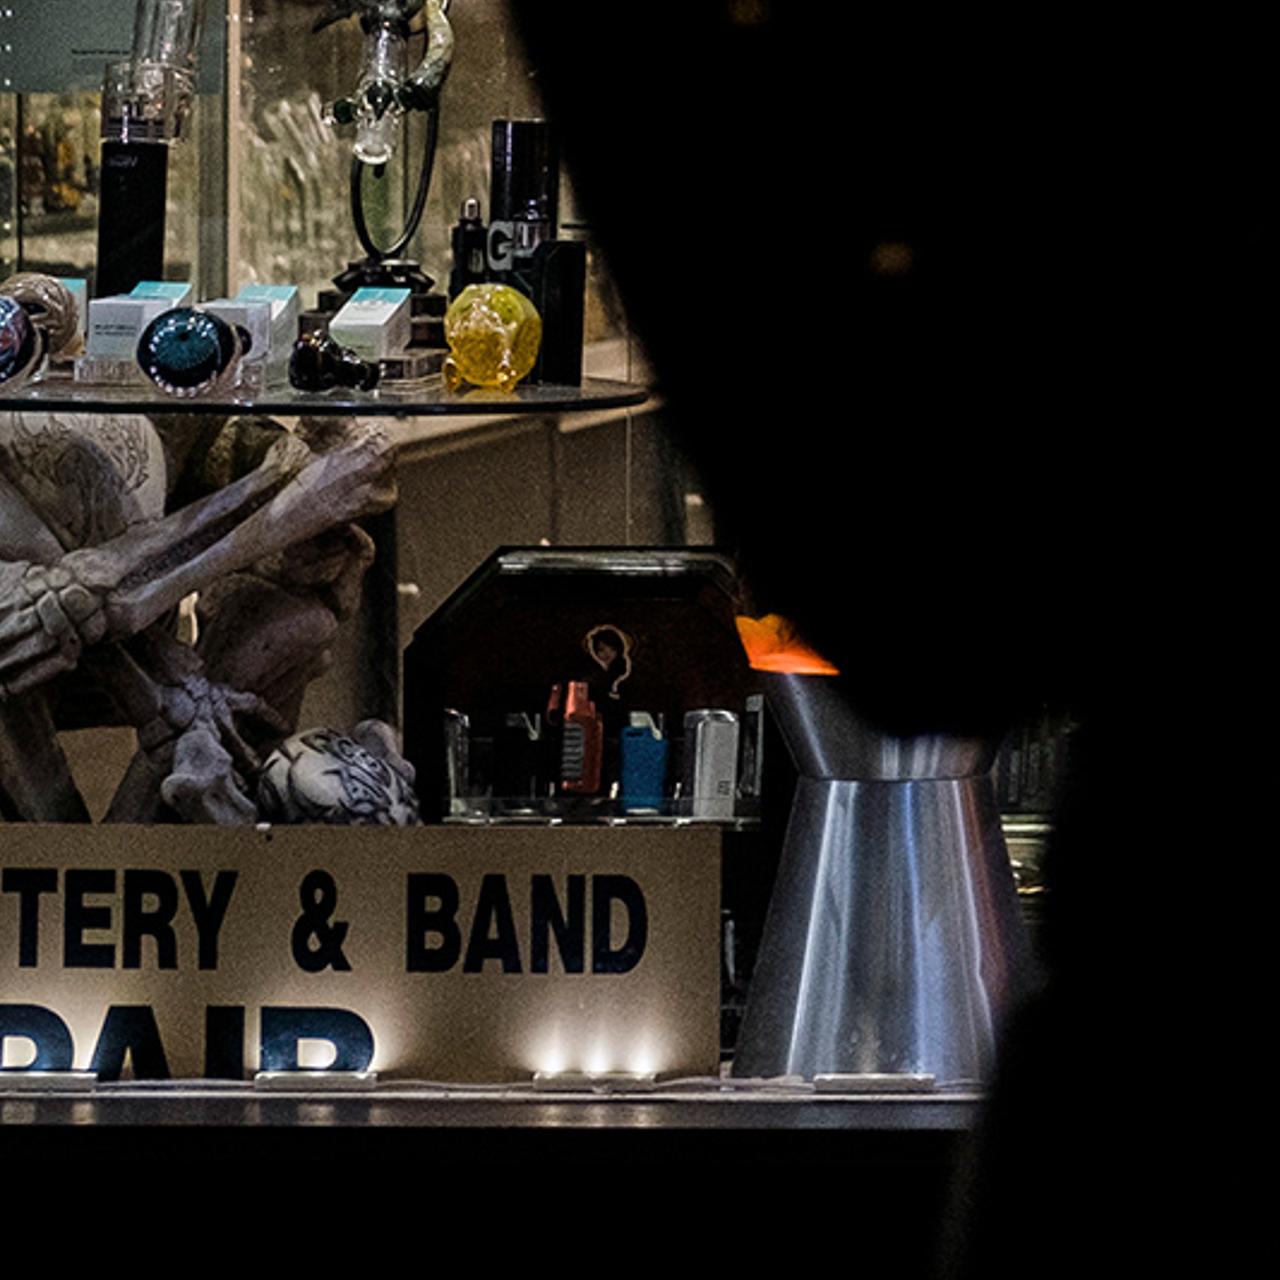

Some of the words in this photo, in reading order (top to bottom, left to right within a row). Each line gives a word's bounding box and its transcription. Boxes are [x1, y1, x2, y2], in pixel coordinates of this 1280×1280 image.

[2, 869, 238, 969] TERY
[291, 870, 351, 971] &
[407, 874, 647, 974] BAND
